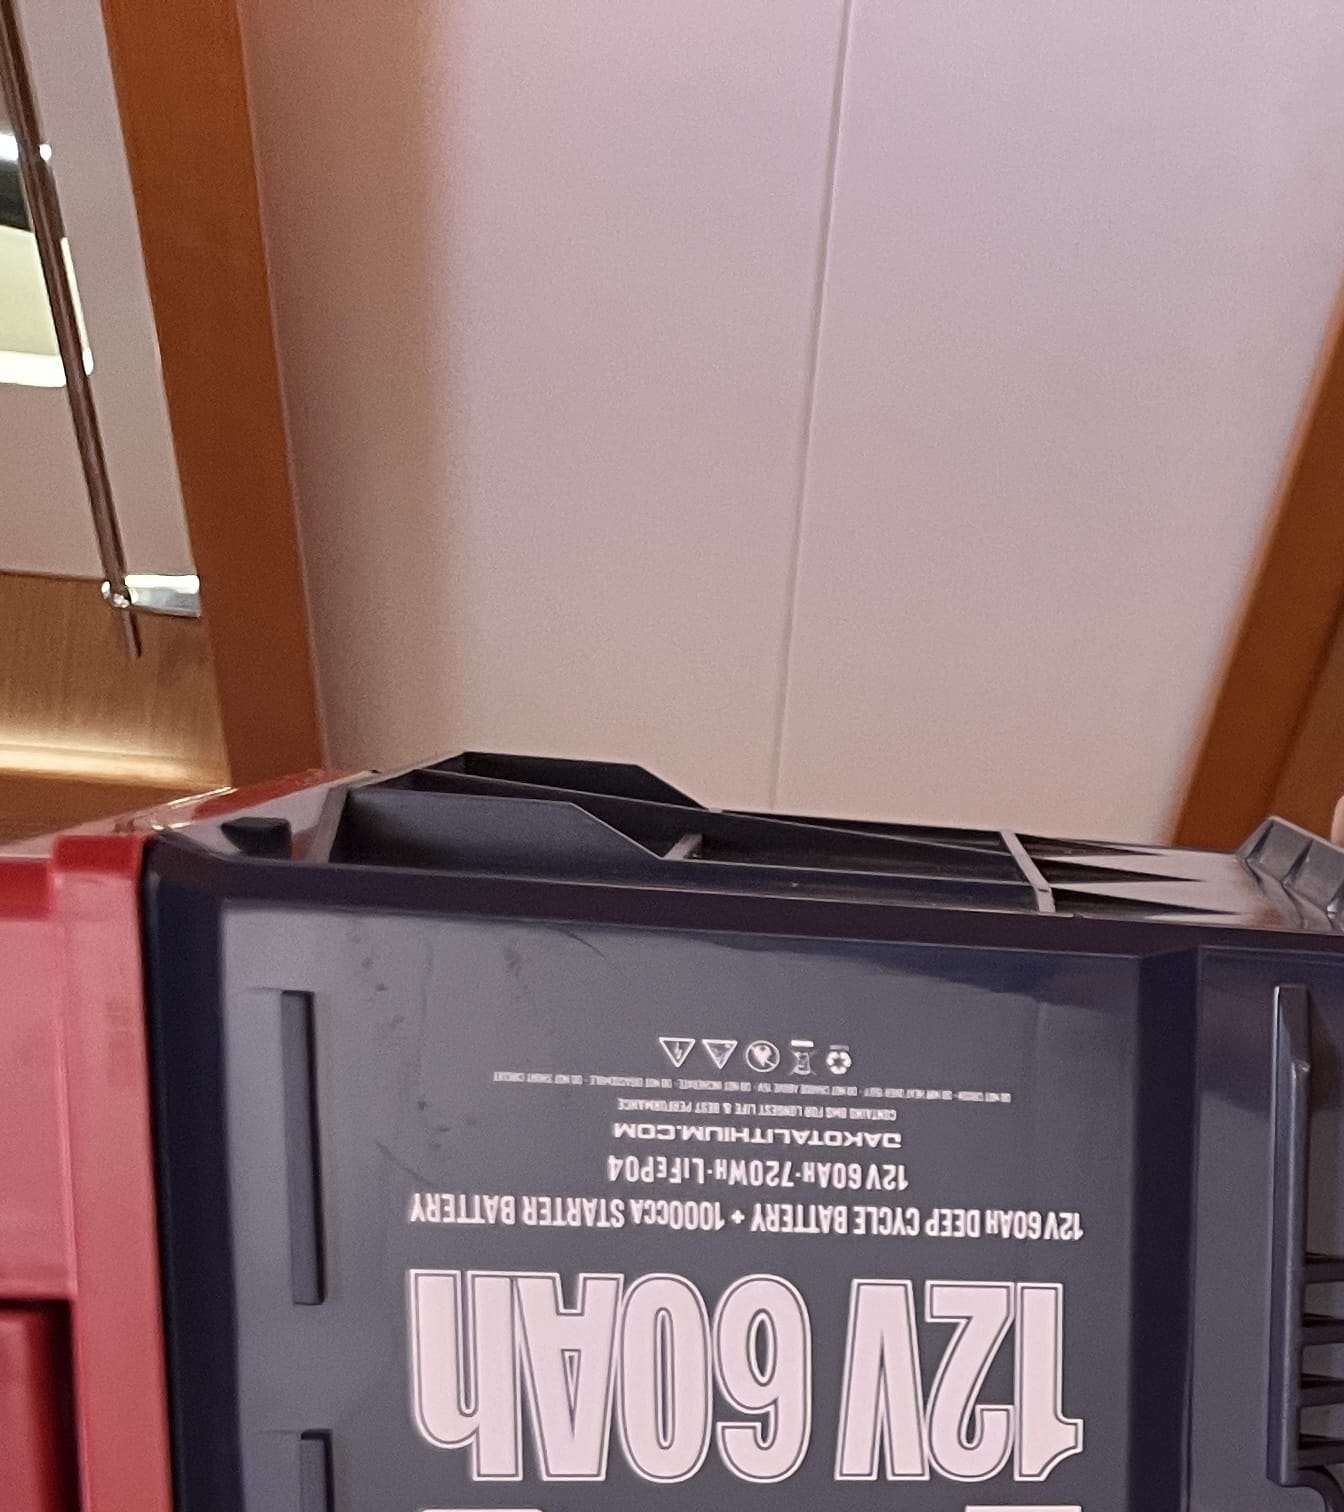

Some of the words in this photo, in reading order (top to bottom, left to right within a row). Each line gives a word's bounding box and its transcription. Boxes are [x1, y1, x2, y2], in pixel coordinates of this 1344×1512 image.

[722, 1103, 732, 1114] &
[735, 1103, 756, 1115] LIFE
[613, 1123, 901, 1148] DAKOTALITHIUM.COM
[866, 1164, 908, 1190] 12V
[408, 1193, 515, 1225] BATTERY
[522, 1196, 624, 1228] STARTER
[750, 1203, 847, 1234] BATTERY
[853, 1206, 919, 1236] CYCLE
[925, 1208, 980, 1237] DEEP
[1044, 1212, 1083, 1240] 12V
[406, 1269, 811, 1483] 60Ah
[834, 1278, 1083, 1482] 12V
